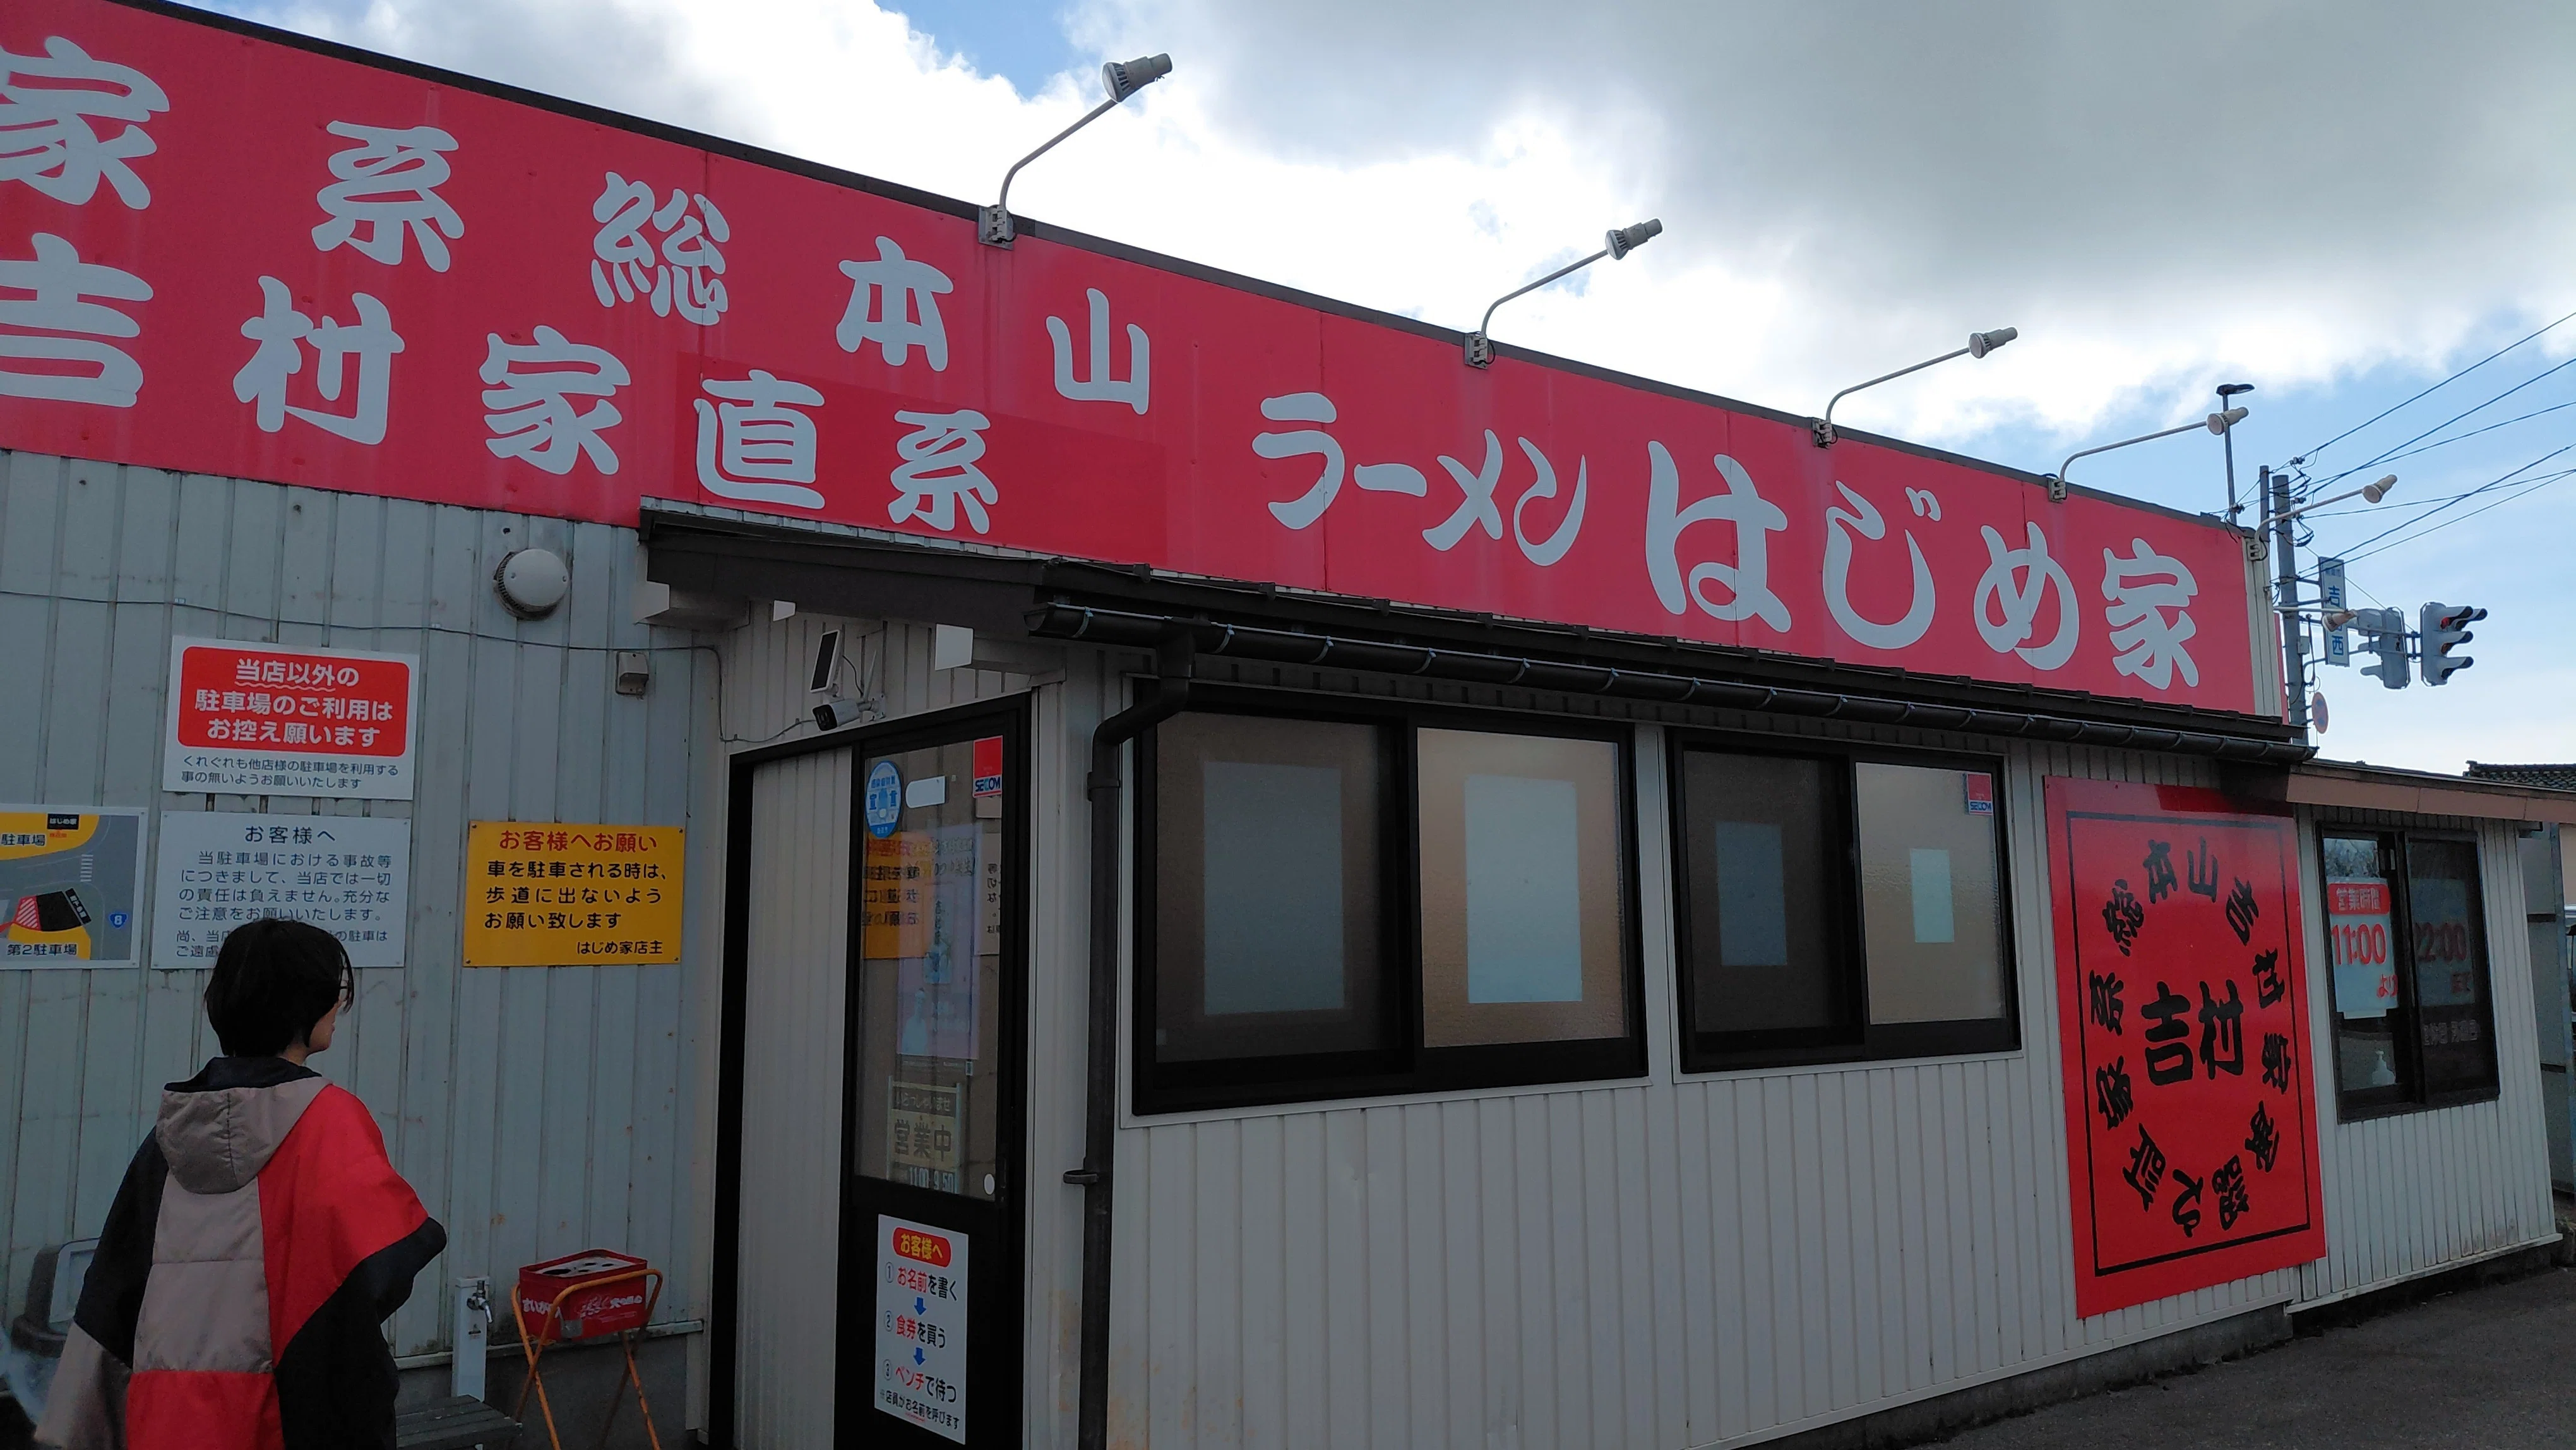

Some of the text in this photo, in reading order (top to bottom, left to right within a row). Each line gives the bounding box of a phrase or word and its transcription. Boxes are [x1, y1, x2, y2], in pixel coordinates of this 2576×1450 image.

[1252, 392, 2198, 690] ラーメン はじめ家
[2328, 585, 2344, 656] 吉西
[235, 657, 360, 688] 当店以外の
[194, 688, 393, 722] 駐車場のご利用は
[206, 717, 381, 748] お控え願います
[182, 755, 399, 777] くれぐれも他店様の駐車場を利用する
[181, 770, 362, 790] 事の無いようお願いいたします
[975, 776, 1001, 792] SECOM
[1, 834, 46, 847] 駐車場
[244, 825, 336, 845] お客様へ
[499, 830, 658, 853] お客様へお願い
[198, 850, 393, 868] 当駐車場における事故等
[487, 860, 667, 880] 車を駐車される時は、
[181, 869, 391, 886] につきまして、当店では一切
[179, 888, 390, 904] の責任は負えません。充分な
[485, 885, 662, 904] 歩道に出ないよう
[2336, 887, 2381, 911] 営業時間
[114, 915, 122, 925] 8
[178, 906, 381, 922] ご注意をお願いいたします。
[484, 912, 622, 930] お願い致します
[7, 943, 78, 956] 第2駐車場
[576, 940, 664, 955] はじめ家店主
[2331, 923, 2387, 966] 11:00
[2376, 973, 2399, 998] より
[2140, 979, 2245, 1088] 吉村
[894, 1118, 951, 1163] 営業中
[900, 1233, 943, 1261] お客様へ
[897, 1266, 958, 1302] お名前を書く
[896, 1314, 946, 1349] 食券を買う
[895, 1364, 957, 1403] ベンチで待つ
